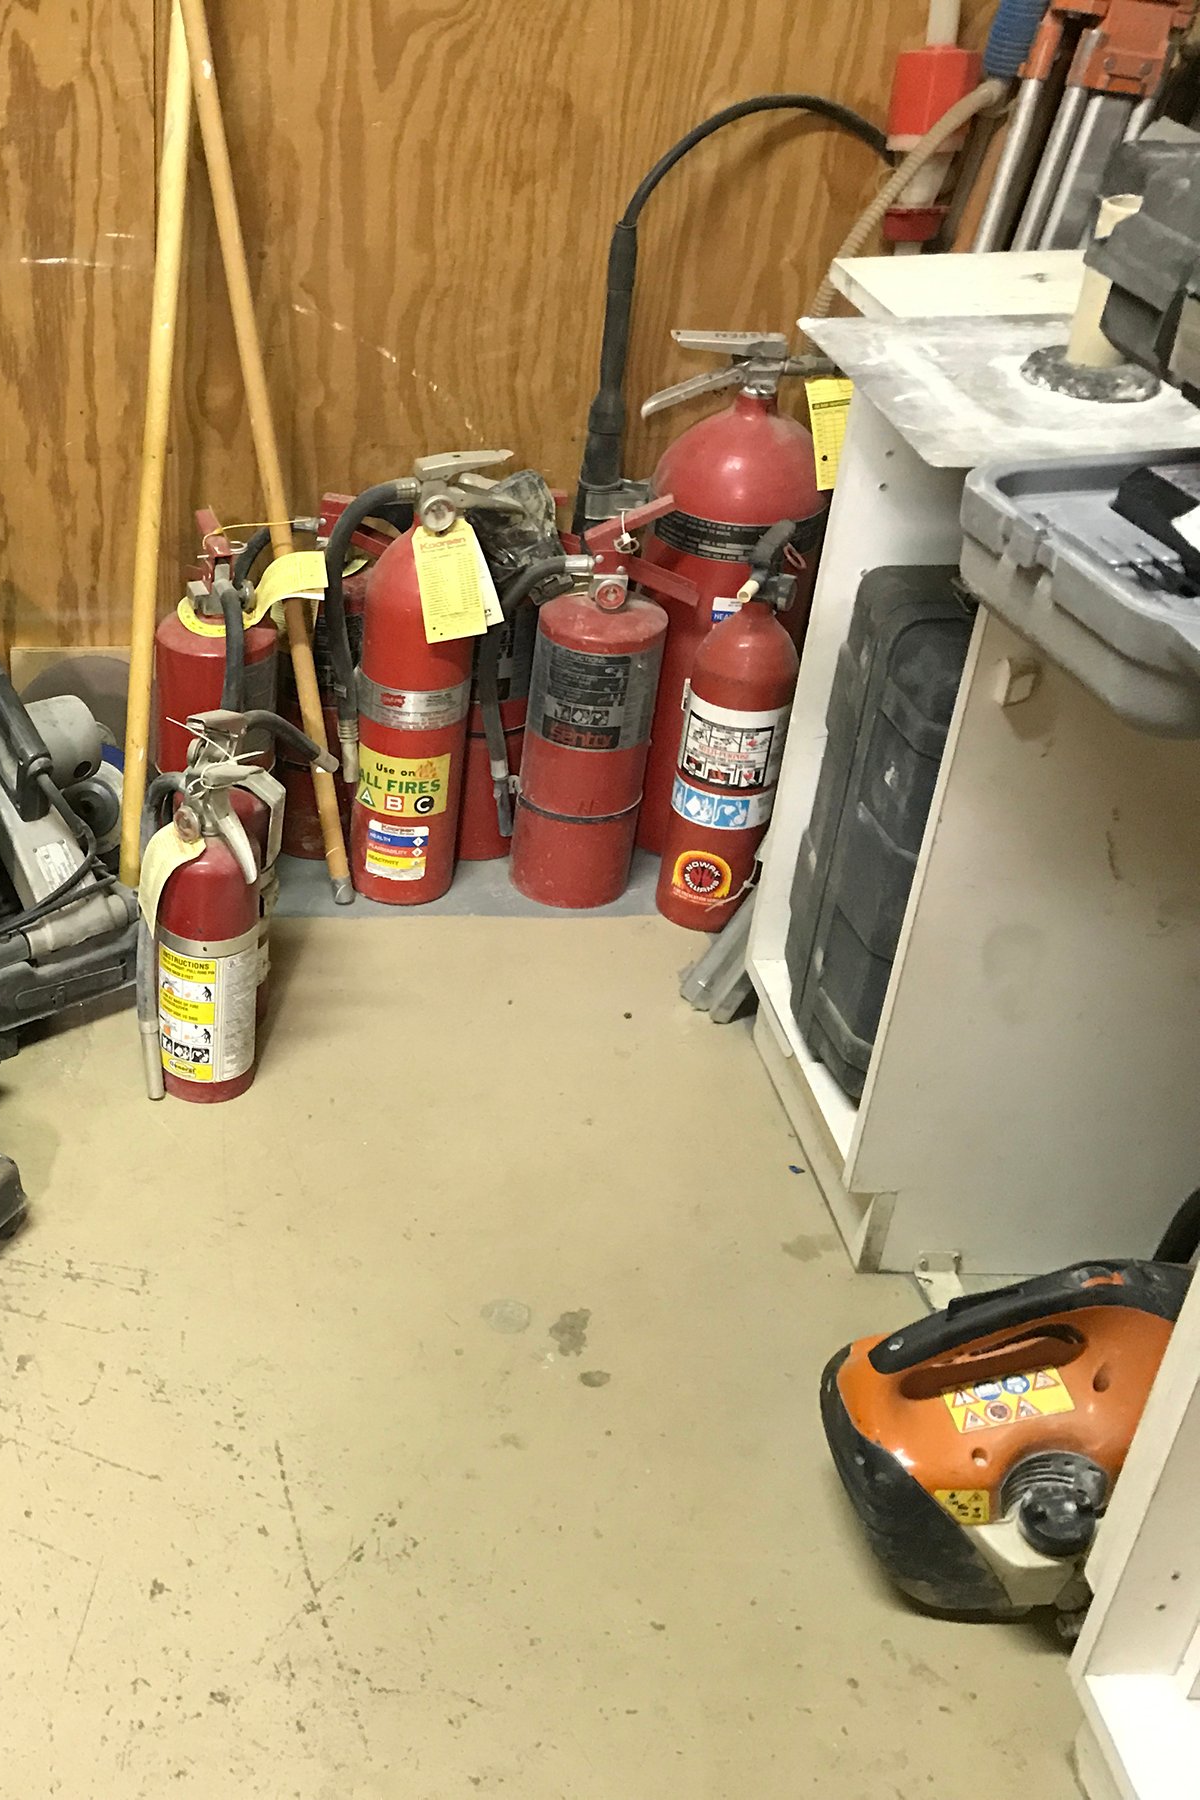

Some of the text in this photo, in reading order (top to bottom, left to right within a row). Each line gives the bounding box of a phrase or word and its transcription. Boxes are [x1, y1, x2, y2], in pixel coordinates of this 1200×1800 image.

[375, 762, 416, 777] Use on
[358, 768, 441, 794] ALL FIRES
[386, 796, 402, 811] B
[415, 797, 431, 813] C
[685, 861, 721, 878] NOWAK
[684, 873, 719, 893] WILLIAMS
[162, 949, 210, 970] INSTRUCTIONS
